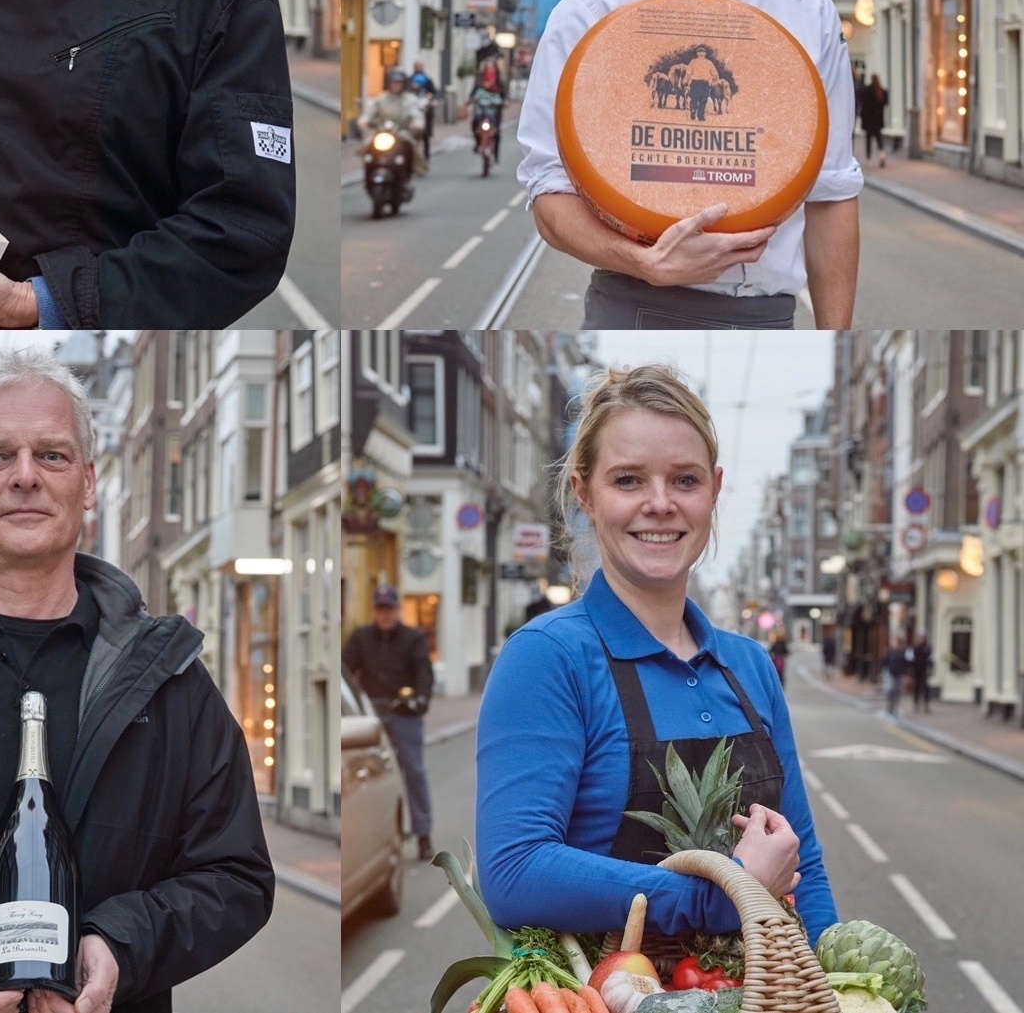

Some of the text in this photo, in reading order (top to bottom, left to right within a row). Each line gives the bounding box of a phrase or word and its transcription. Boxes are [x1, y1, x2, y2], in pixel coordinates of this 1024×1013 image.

[631, 124, 756, 153] DE ORIGINELE
[631, 152, 756, 168] ECHTE BOERENKAAS
[707, 171, 752, 183] TROMP
